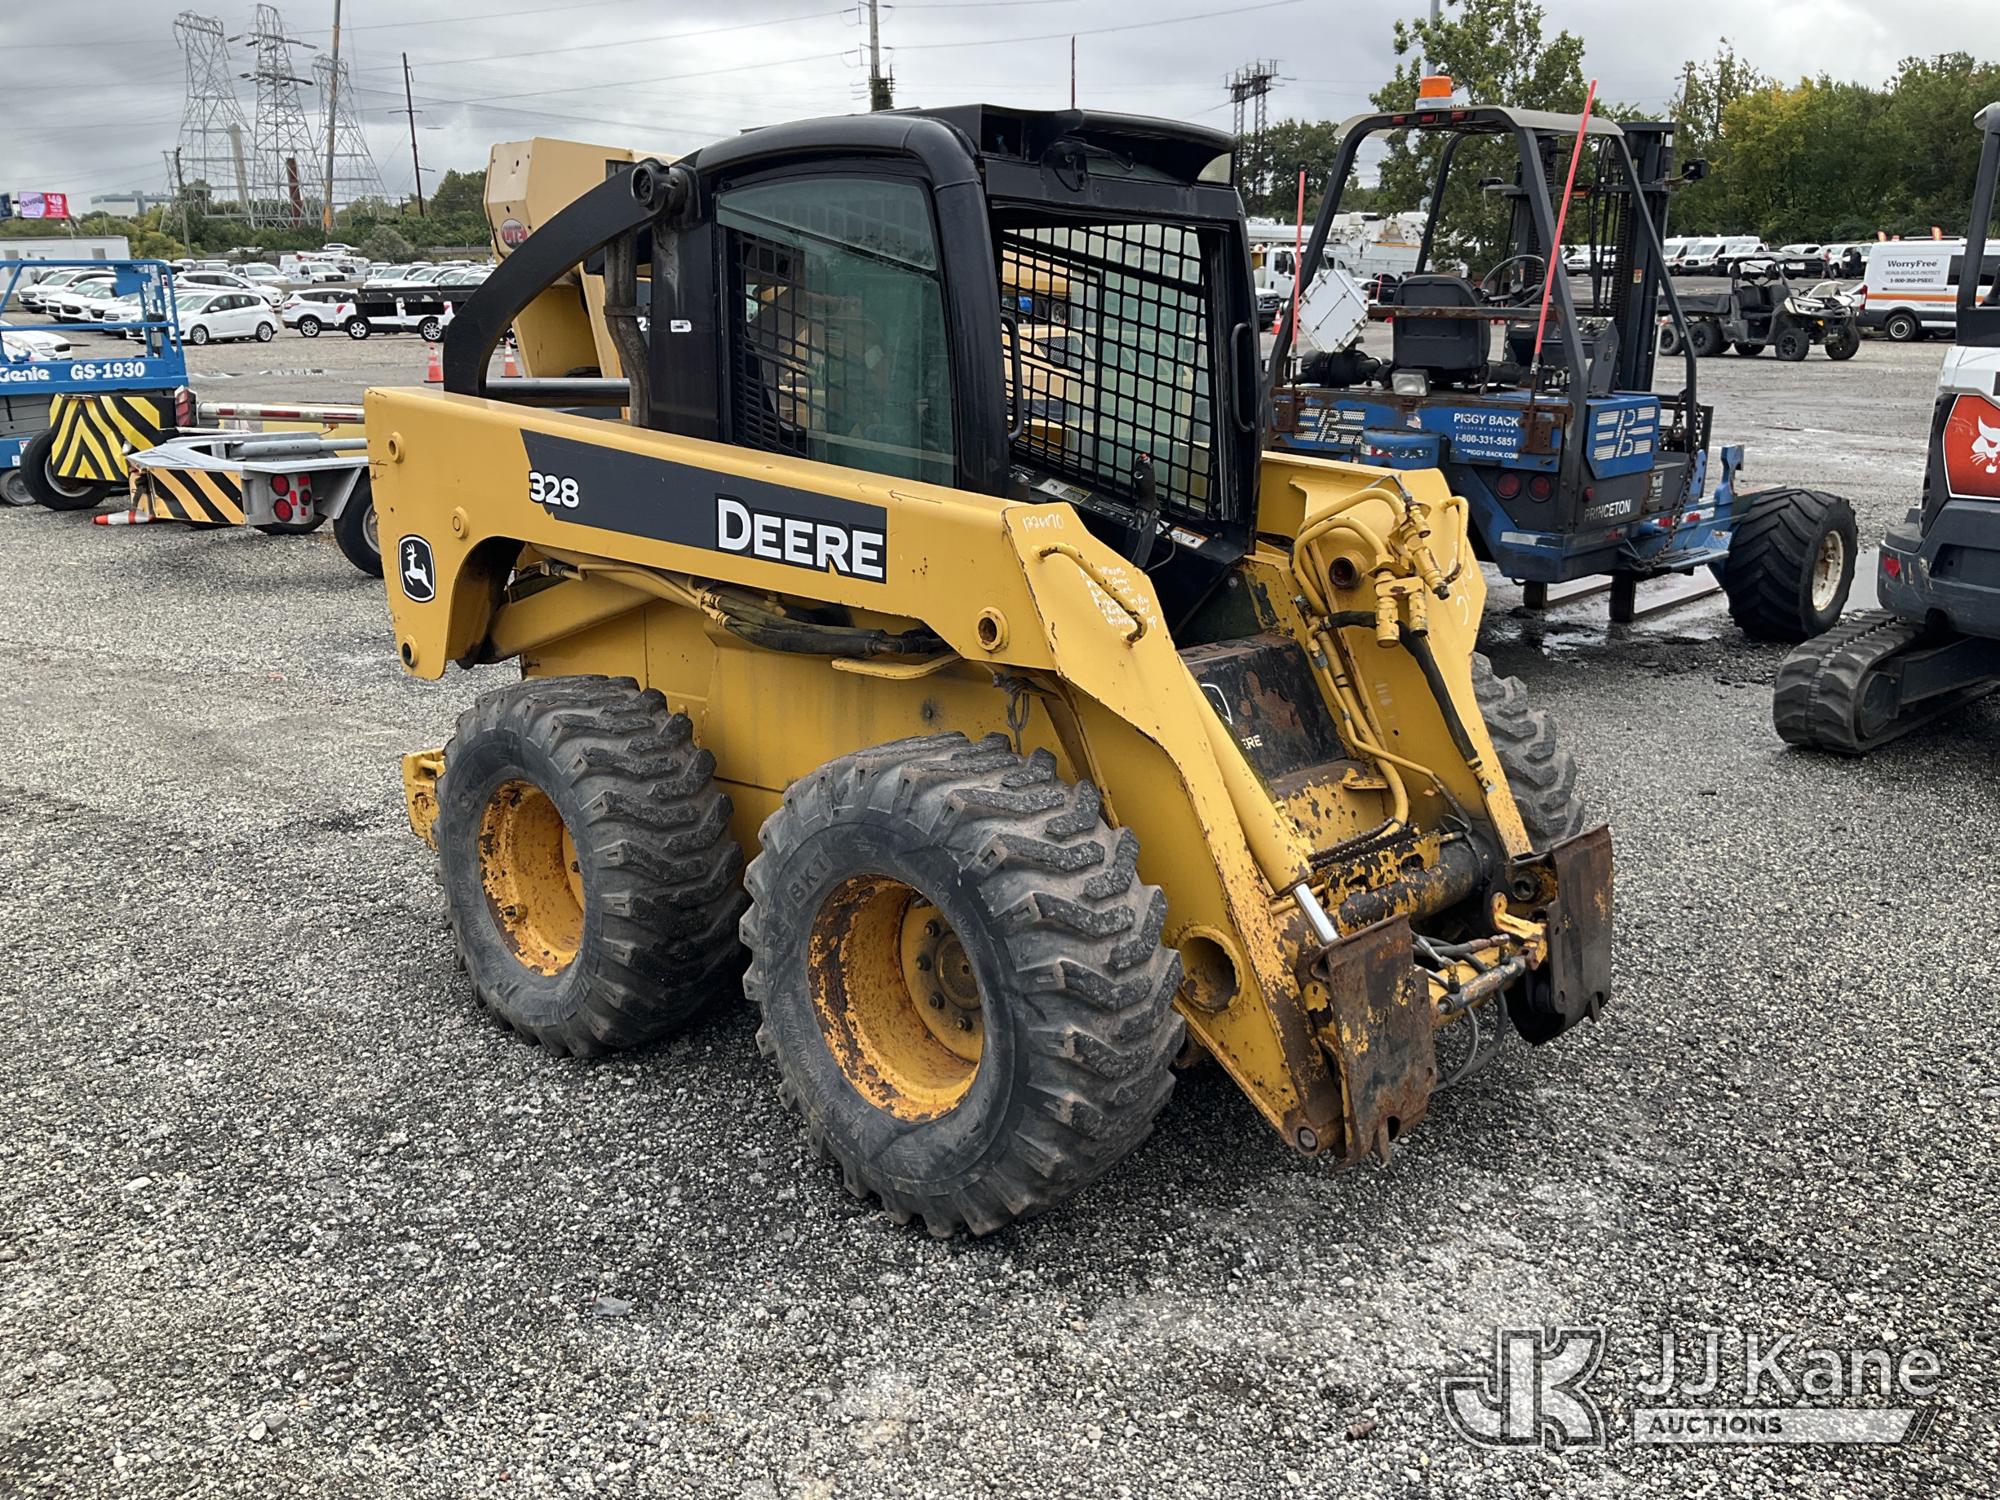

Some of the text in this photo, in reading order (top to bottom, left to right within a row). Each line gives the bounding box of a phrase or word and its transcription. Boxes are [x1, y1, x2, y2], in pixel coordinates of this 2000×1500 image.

[1887, 260, 1938, 269] WorryFree
[0, 366, 50, 381] Genie
[70, 362, 145, 380] GS-1930
[1453, 412, 1519, 427] PIGGY BACK
[1455, 433, 1517, 447] 1-800-331-5851
[529, 472, 579, 508] 328
[1584, 500, 1631, 520] PRINCETON
[717, 498, 884, 579] DEERE
